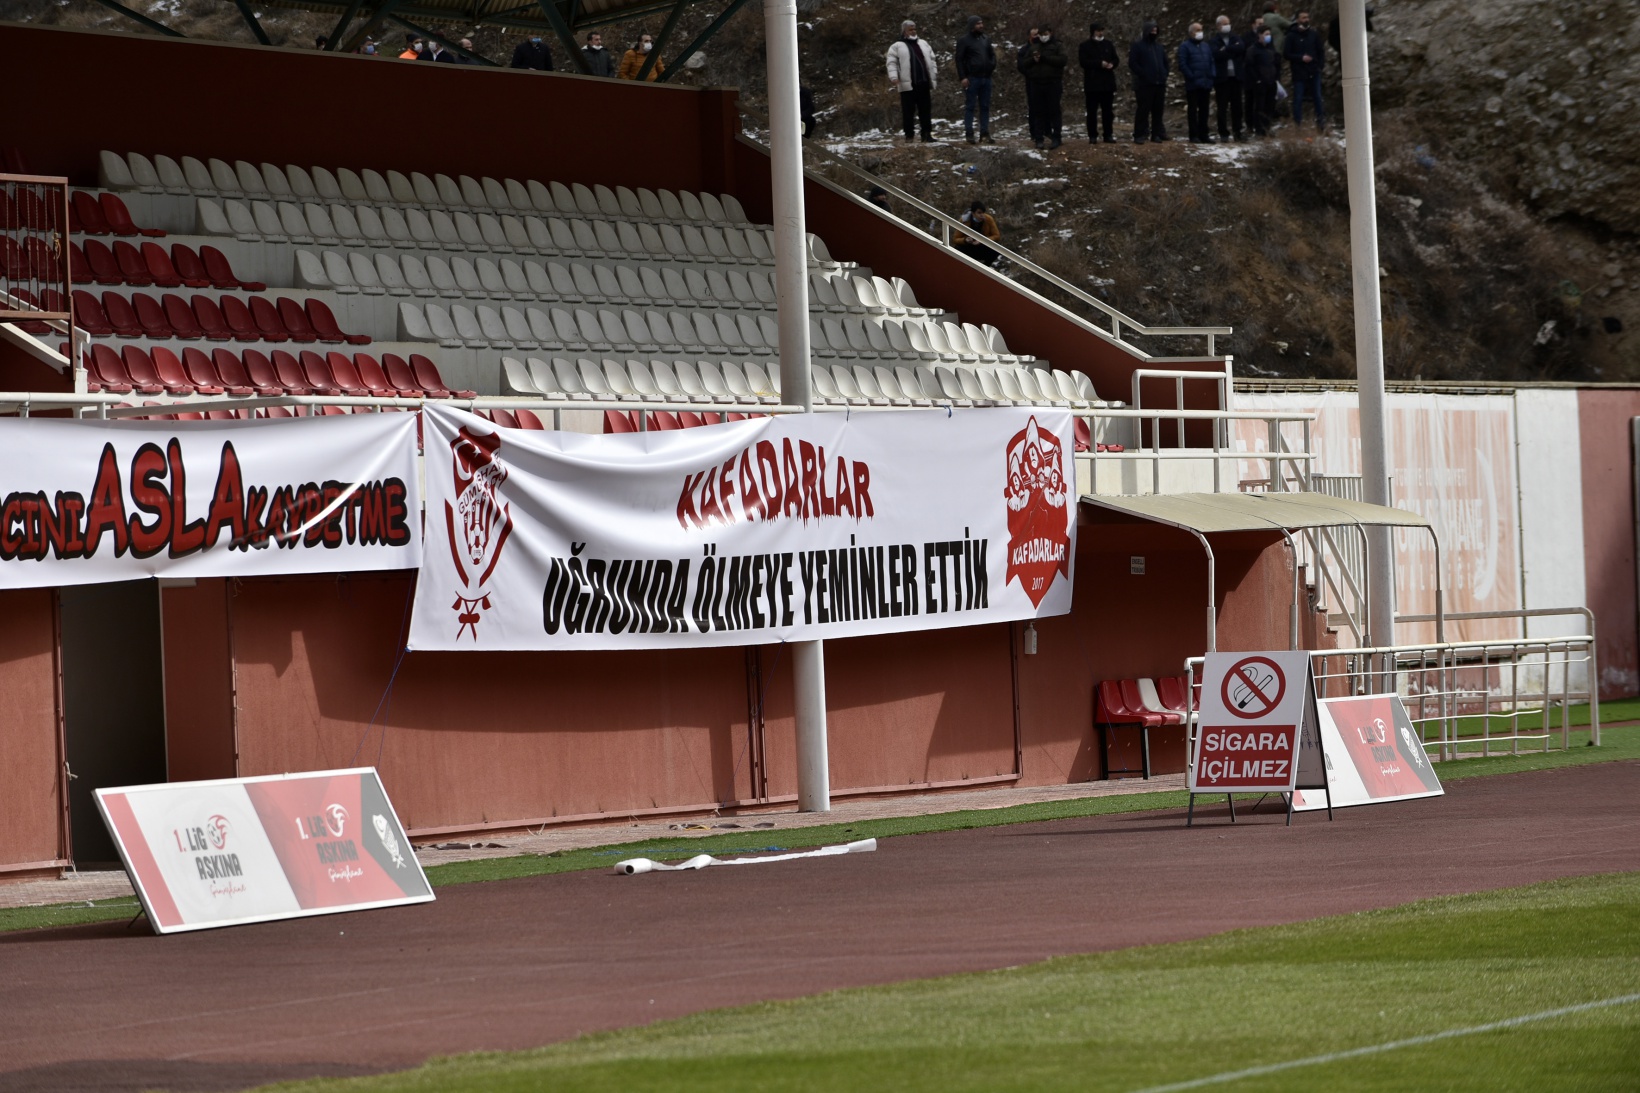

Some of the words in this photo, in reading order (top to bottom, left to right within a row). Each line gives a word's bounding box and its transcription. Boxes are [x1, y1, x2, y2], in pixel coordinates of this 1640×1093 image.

[676, 437, 875, 531] KAFADARLAR
[0, 490, 85, 561] CINI
[82, 436, 248, 560] ASLA
[229, 476, 411, 551] KAYBETME
[1012, 537, 1065, 566] KAFADARLAR
[542, 541, 690, 635] UĞRUNDA
[692, 543, 795, 633] ÖLMEYE
[799, 533, 917, 624] YEMİNLER
[924, 525, 989, 613] ETTİK
[1032, 577, 1044, 591] 2017
[1205, 729, 1290, 751] SİGARA
[1201, 756, 1288, 783] İÇİLMEZ
[173, 829, 186, 852] 1.
[295, 817, 309, 840] 1.
[316, 839, 359, 867] AŞKINA
[195, 853, 243, 884] AŞKINA
